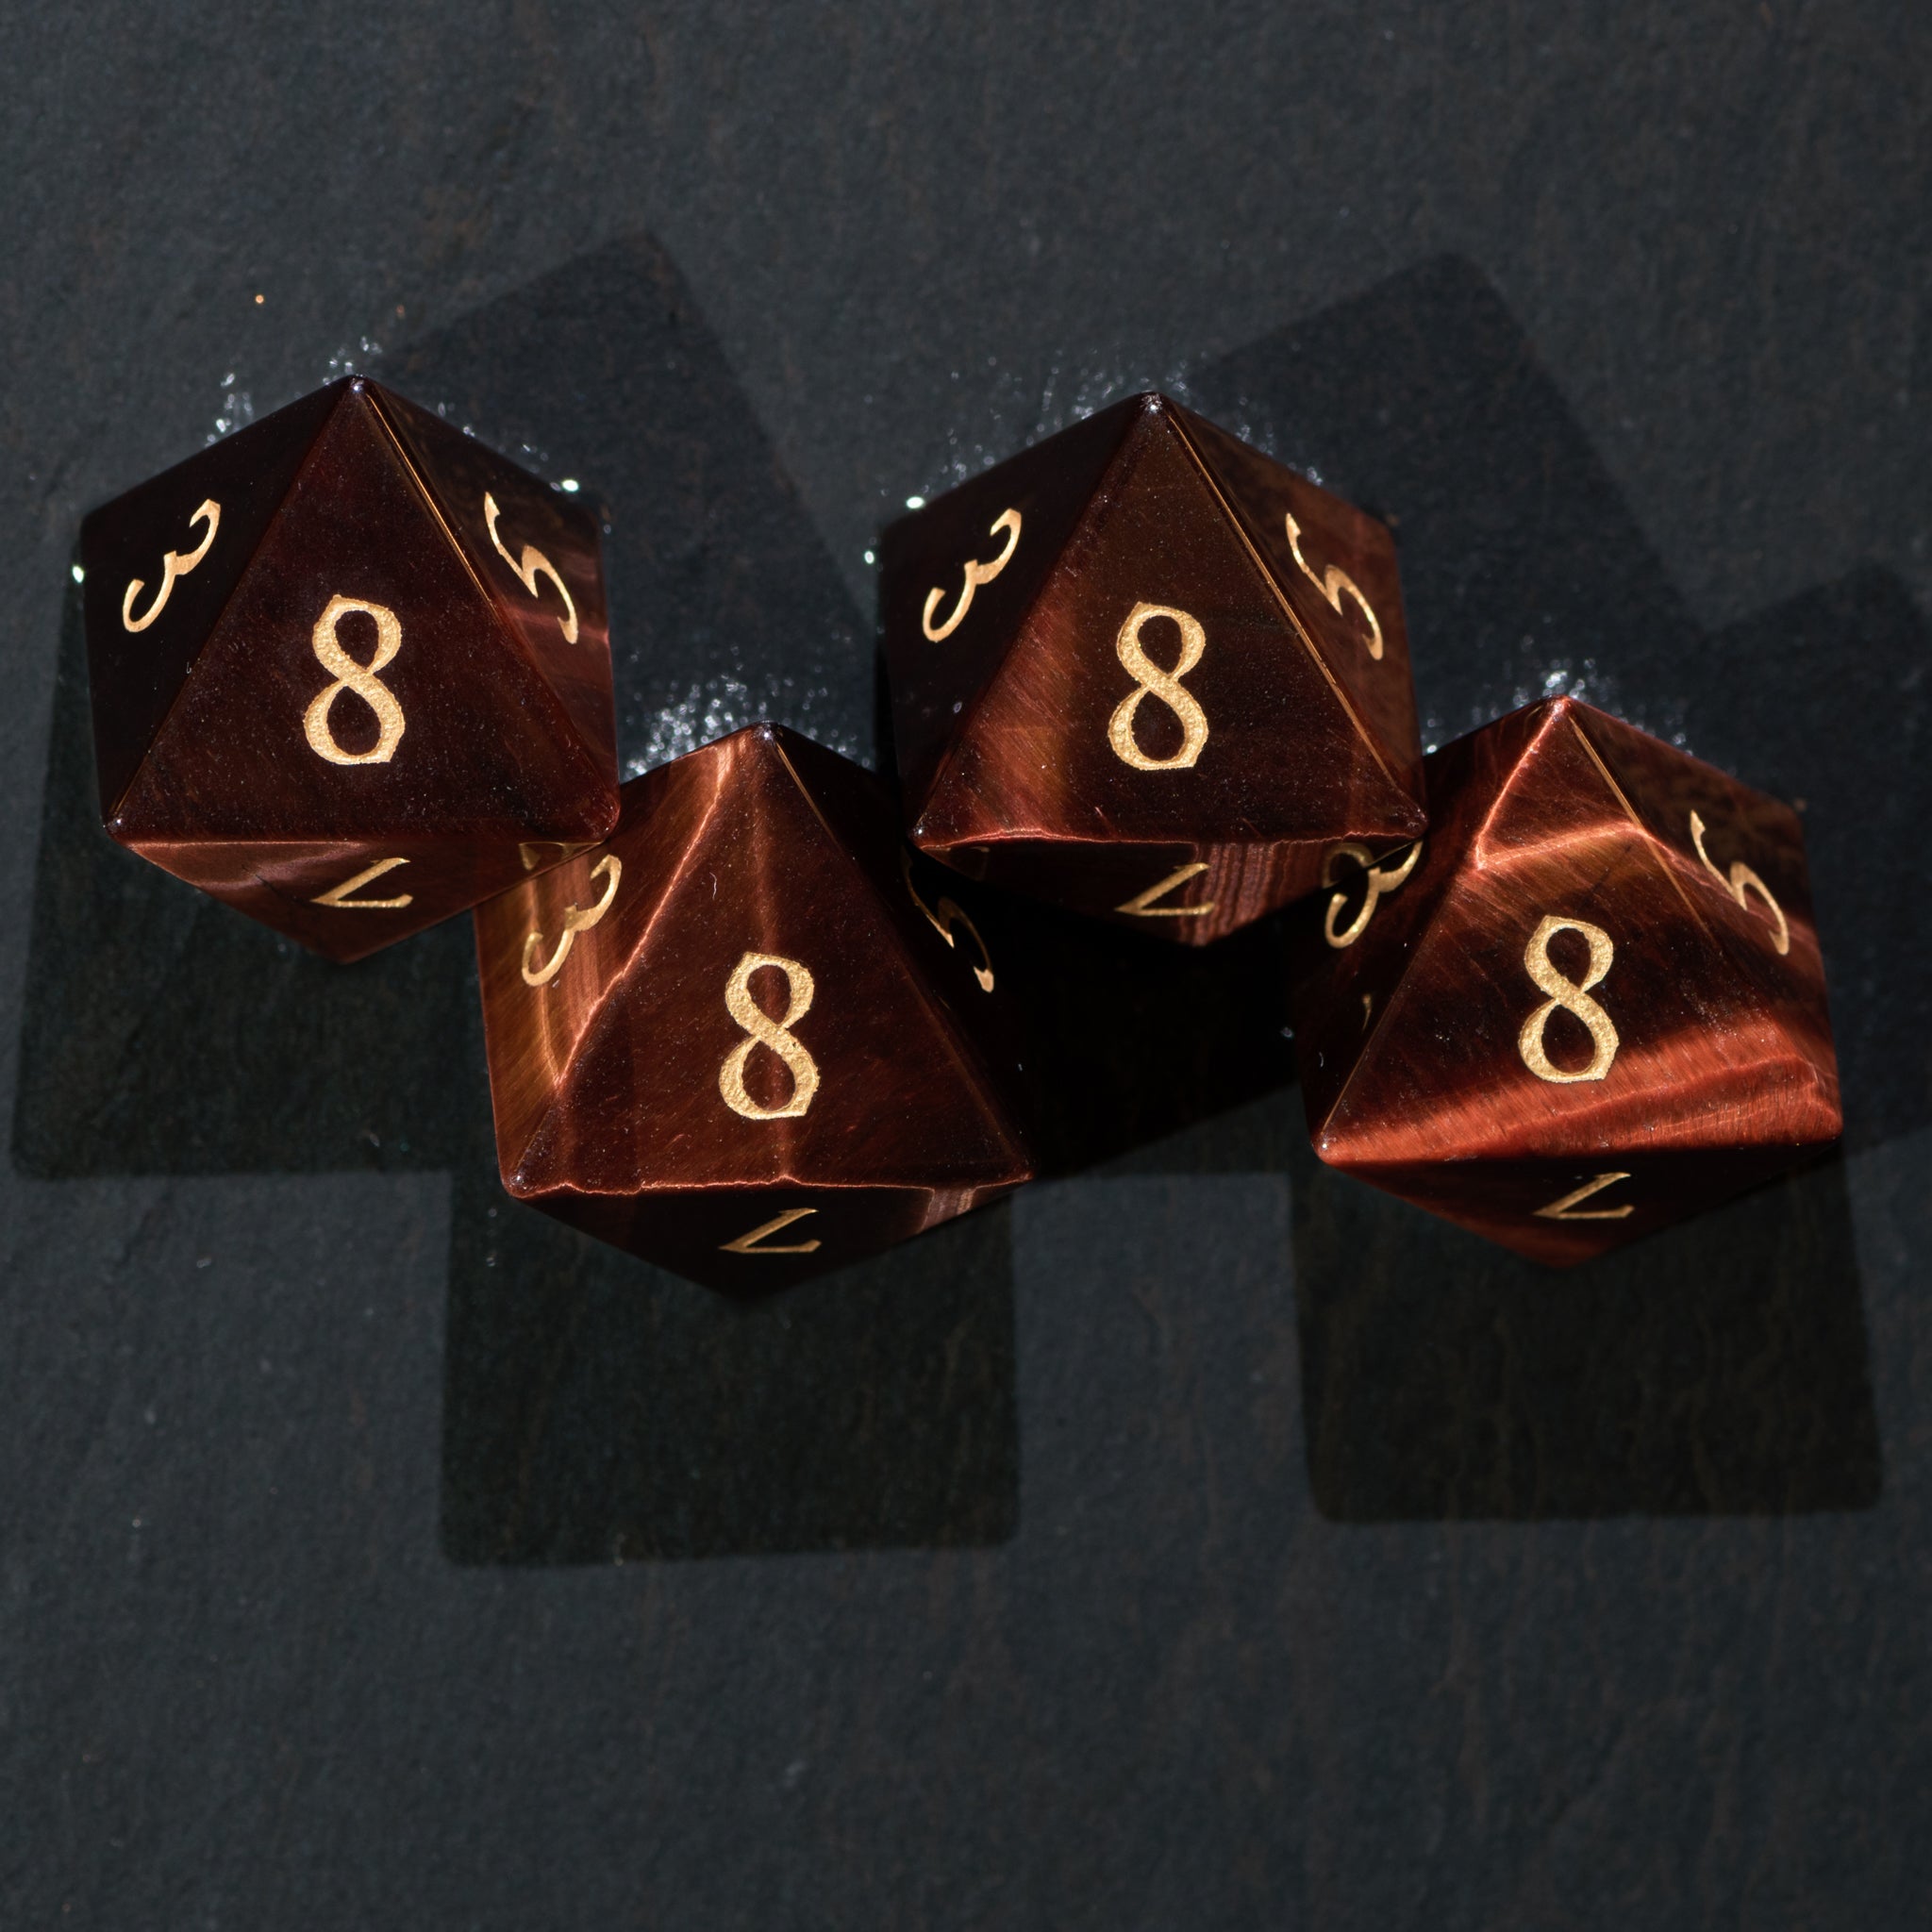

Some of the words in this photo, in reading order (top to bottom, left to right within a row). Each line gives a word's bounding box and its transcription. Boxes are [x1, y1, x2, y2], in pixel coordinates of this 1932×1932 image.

[123, 498, 221, 632] 3
[485, 491, 578, 644] 5
[923, 508, 1021, 642] 3
[1286, 512, 1383, 659] 5
[303, 594, 406, 765] 8
[1107, 601, 1208, 771] 8
[522, 854, 623, 987] 3
[1690, 809, 1789, 955] 5
[719, 951, 820, 1120] 8
[1518, 914, 1619, 1084] 8
